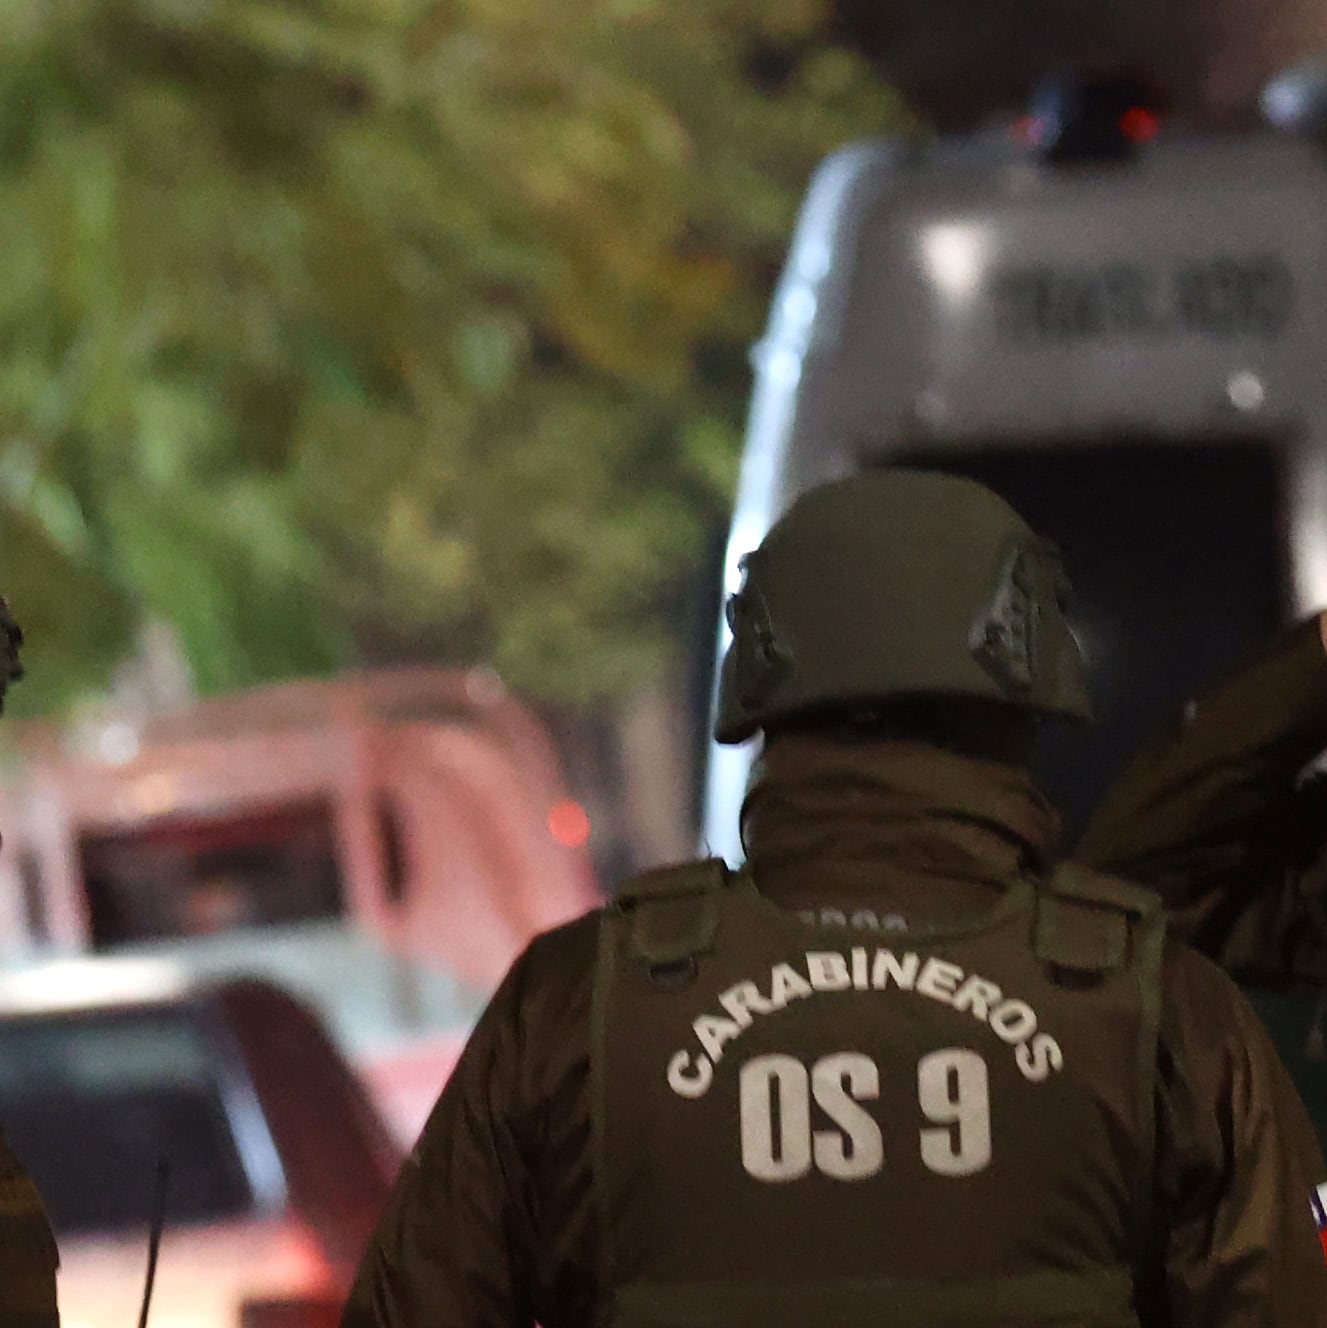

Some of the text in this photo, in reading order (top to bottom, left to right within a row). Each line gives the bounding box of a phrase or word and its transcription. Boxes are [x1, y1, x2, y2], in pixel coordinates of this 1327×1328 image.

[667, 946, 1063, 1099] CARABINEROS
[739, 1047, 992, 1182] OS 9
